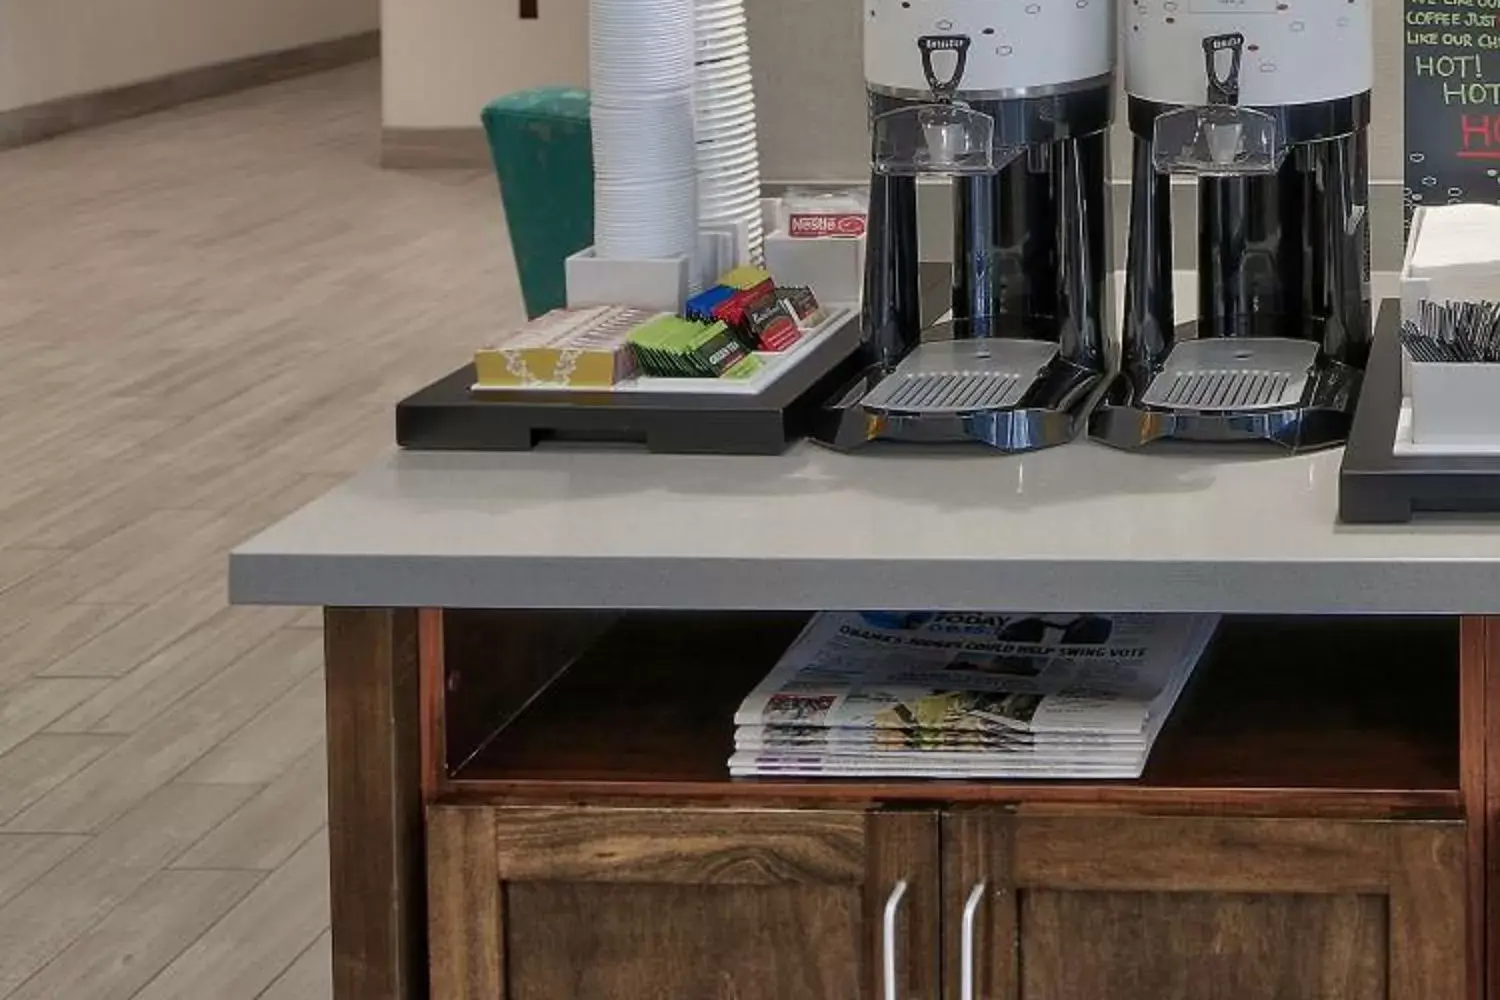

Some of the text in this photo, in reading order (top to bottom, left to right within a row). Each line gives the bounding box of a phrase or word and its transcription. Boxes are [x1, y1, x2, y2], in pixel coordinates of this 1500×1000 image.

[1406, 10, 1497, 28] COFFEE JUST
[1407, 30, 1438, 45] LIKE
[1441, 33, 1472, 47] OUR
[1415, 53, 1483, 79] HOT!
